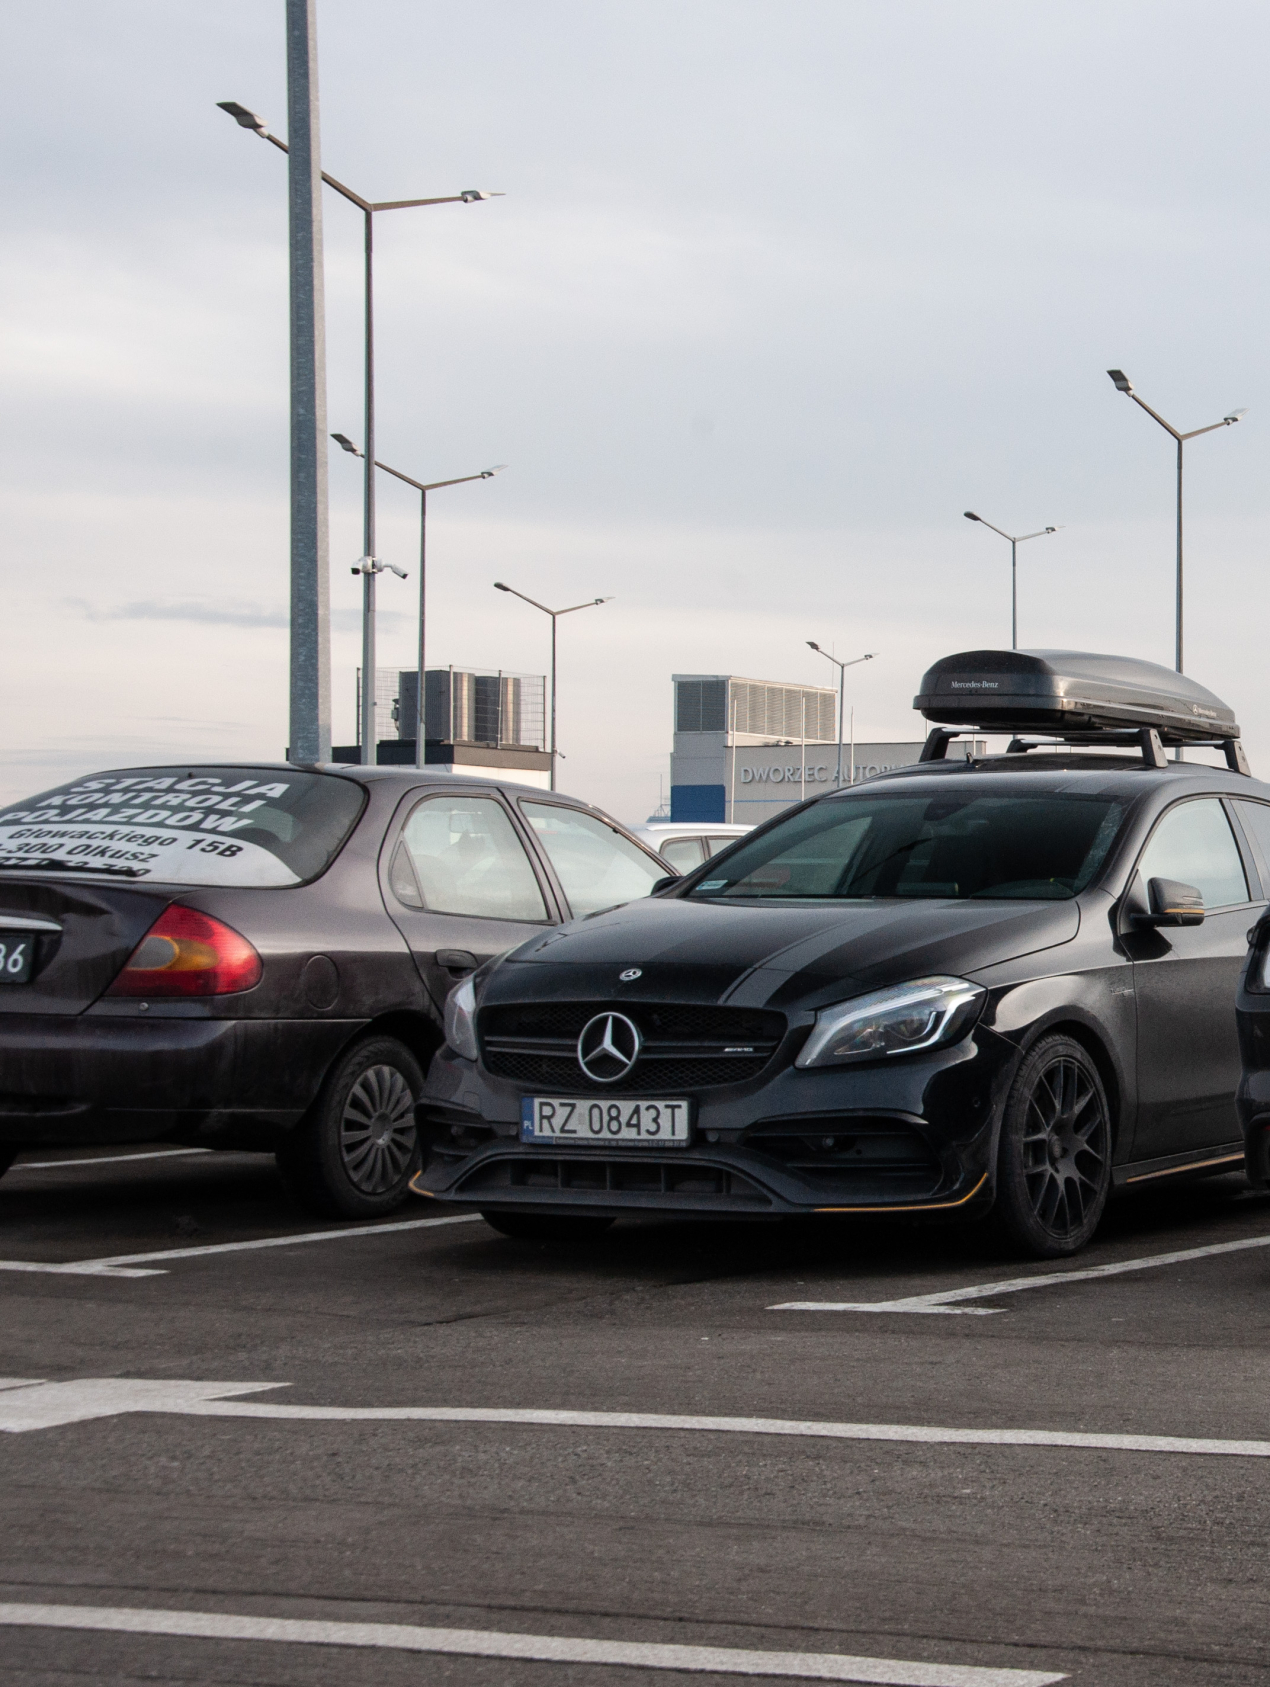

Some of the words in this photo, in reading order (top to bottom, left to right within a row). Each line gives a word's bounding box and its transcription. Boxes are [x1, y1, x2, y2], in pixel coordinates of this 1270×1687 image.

[951, 681, 999, 689] Mercedes-Benz
[740, 765, 828, 783] DWORZEC
[70, 777, 291, 799] STACJA
[35, 792, 267, 813] KONTROLI
[0, 808, 255, 832] POJAZDÓW
[65, 844, 160, 863] Olkusz
[185, 838, 244, 858] 15B
[523, 1120, 534, 1130] PL
[538, 1101, 578, 1134] RZ
[588, 1103, 683, 1137] 0843T
